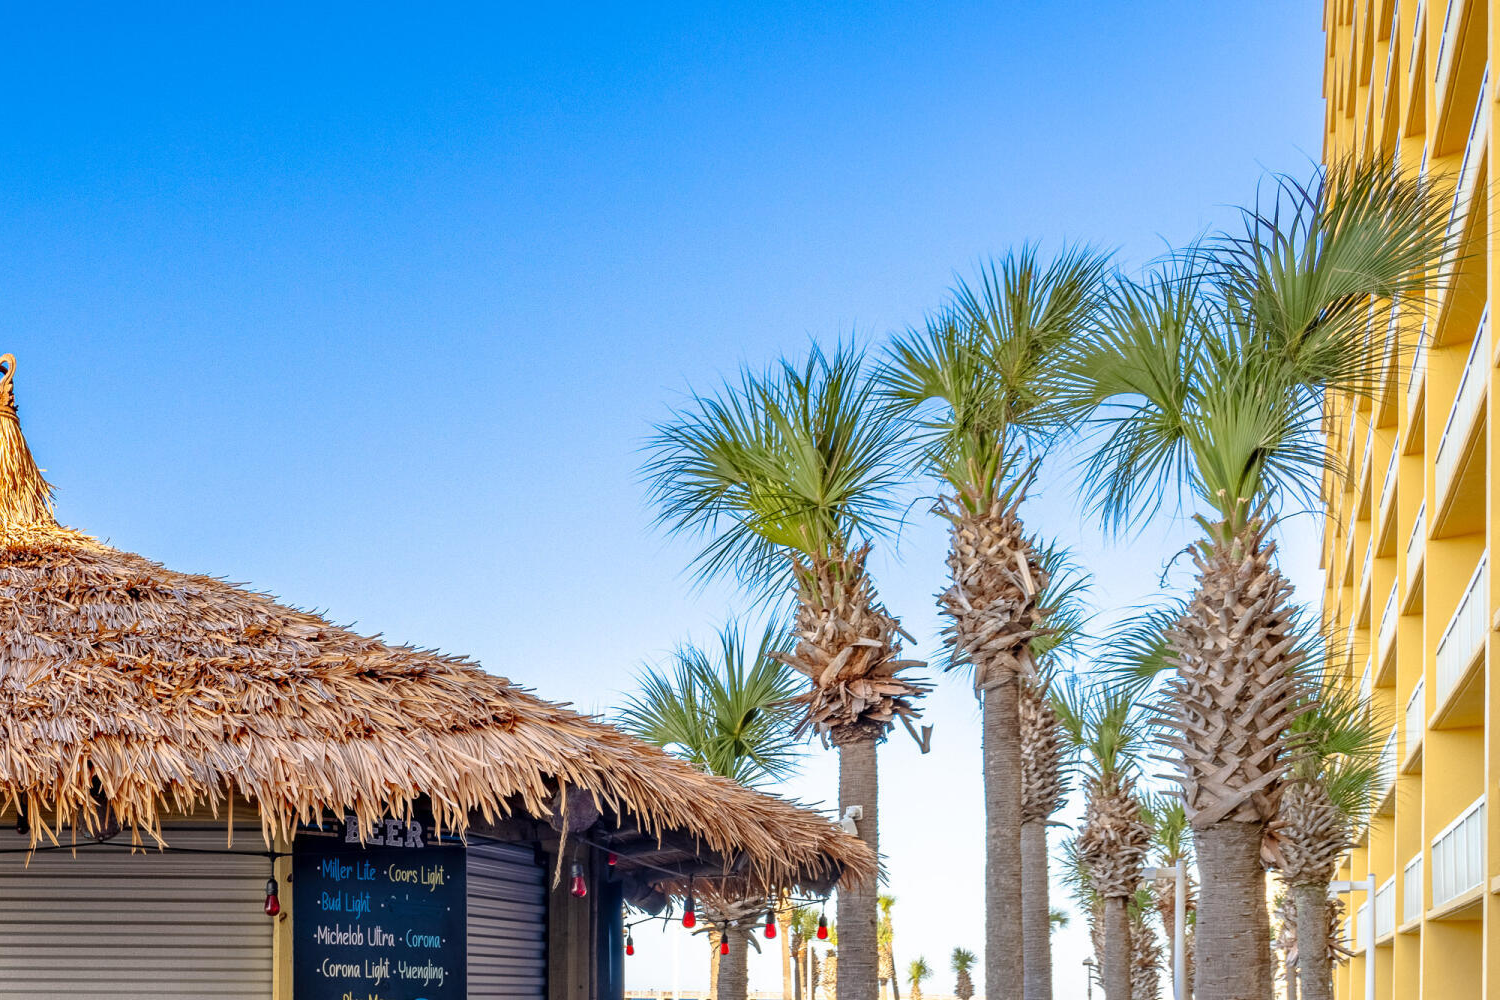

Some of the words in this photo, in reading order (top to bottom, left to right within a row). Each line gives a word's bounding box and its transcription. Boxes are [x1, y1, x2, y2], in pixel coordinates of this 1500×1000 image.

[345, 815, 424, 848] BEER
[322, 857, 353, 882] Miller
[357, 860, 377, 881] Lite
[389, 863, 418, 884] Coors
[421, 864, 445, 892] Light
[321, 890, 342, 911] Bud
[345, 892, 371, 920] Light
[317, 923, 364, 946] Michelob
[367, 926, 395, 947] Ultra
[405, 929, 441, 948] Corona
[322, 957, 361, 978] Corona
[365, 957, 390, 986] Light
[398, 959, 444, 987] Yuengling
